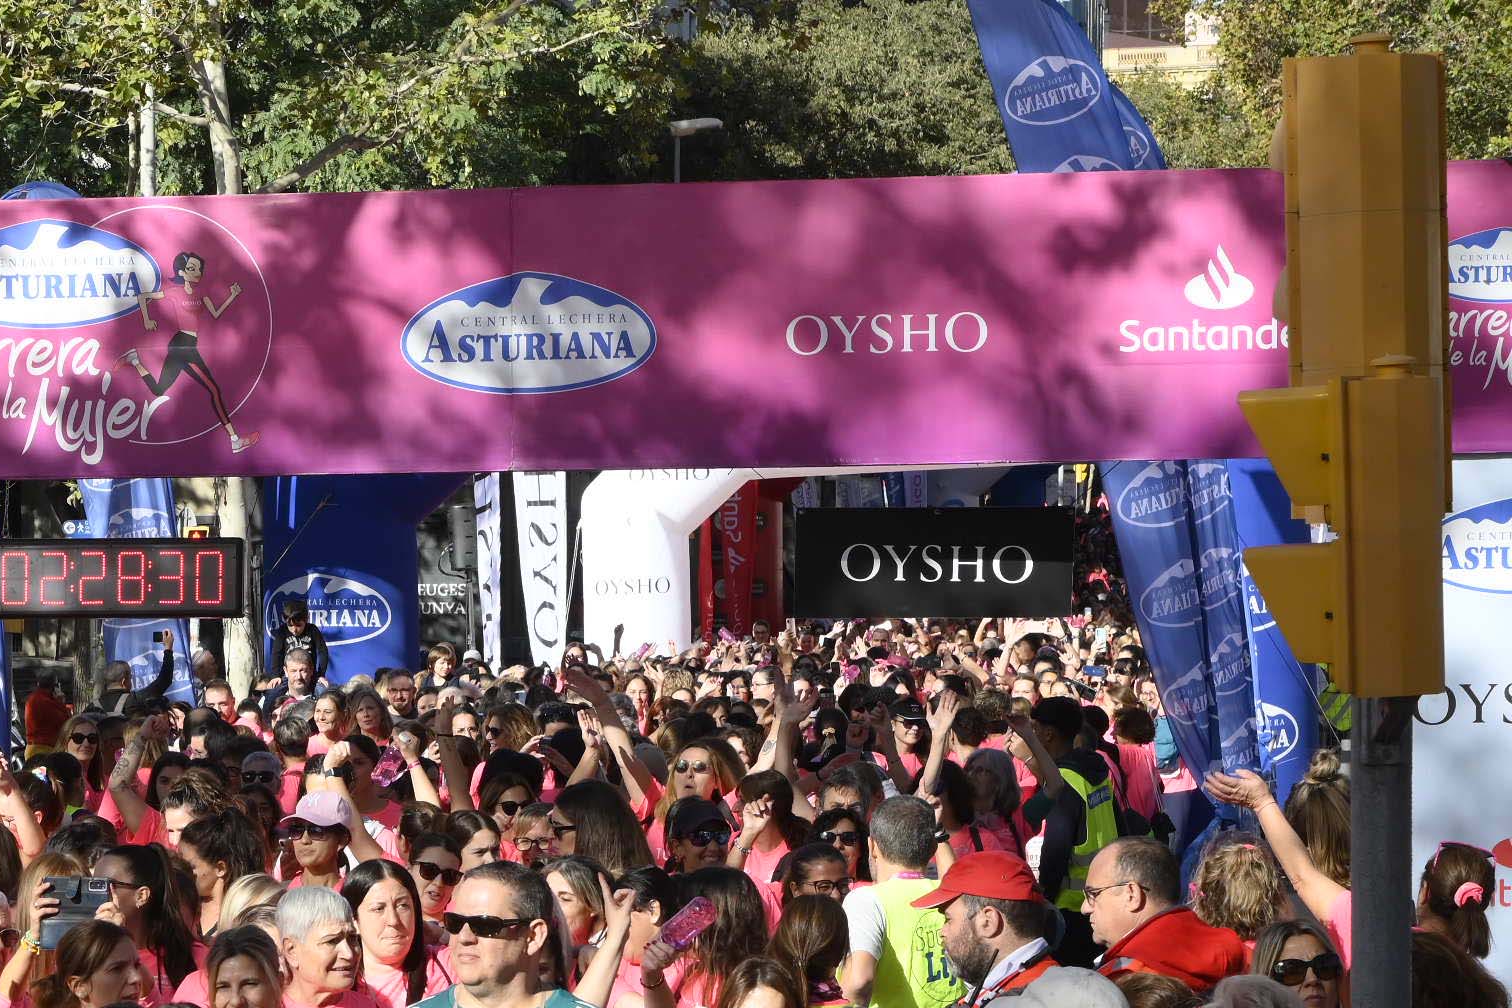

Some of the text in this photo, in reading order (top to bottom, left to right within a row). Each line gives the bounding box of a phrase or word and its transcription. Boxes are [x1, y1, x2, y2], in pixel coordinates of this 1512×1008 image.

[422, 319, 636, 364] ASTURIANA
[460, 312, 629, 328] CENTRAL LECHERA
[787, 310, 988, 357] OYSHO
[1, 382, 28, 420] la
[22, 371, 171, 465] Mujer
[1, 550, 225, 605] 02:28:30
[595, 577, 671, 596] OYSHO
[840, 543, 1035, 586] OYSHO
[328, 598, 377, 607] LECHERA
